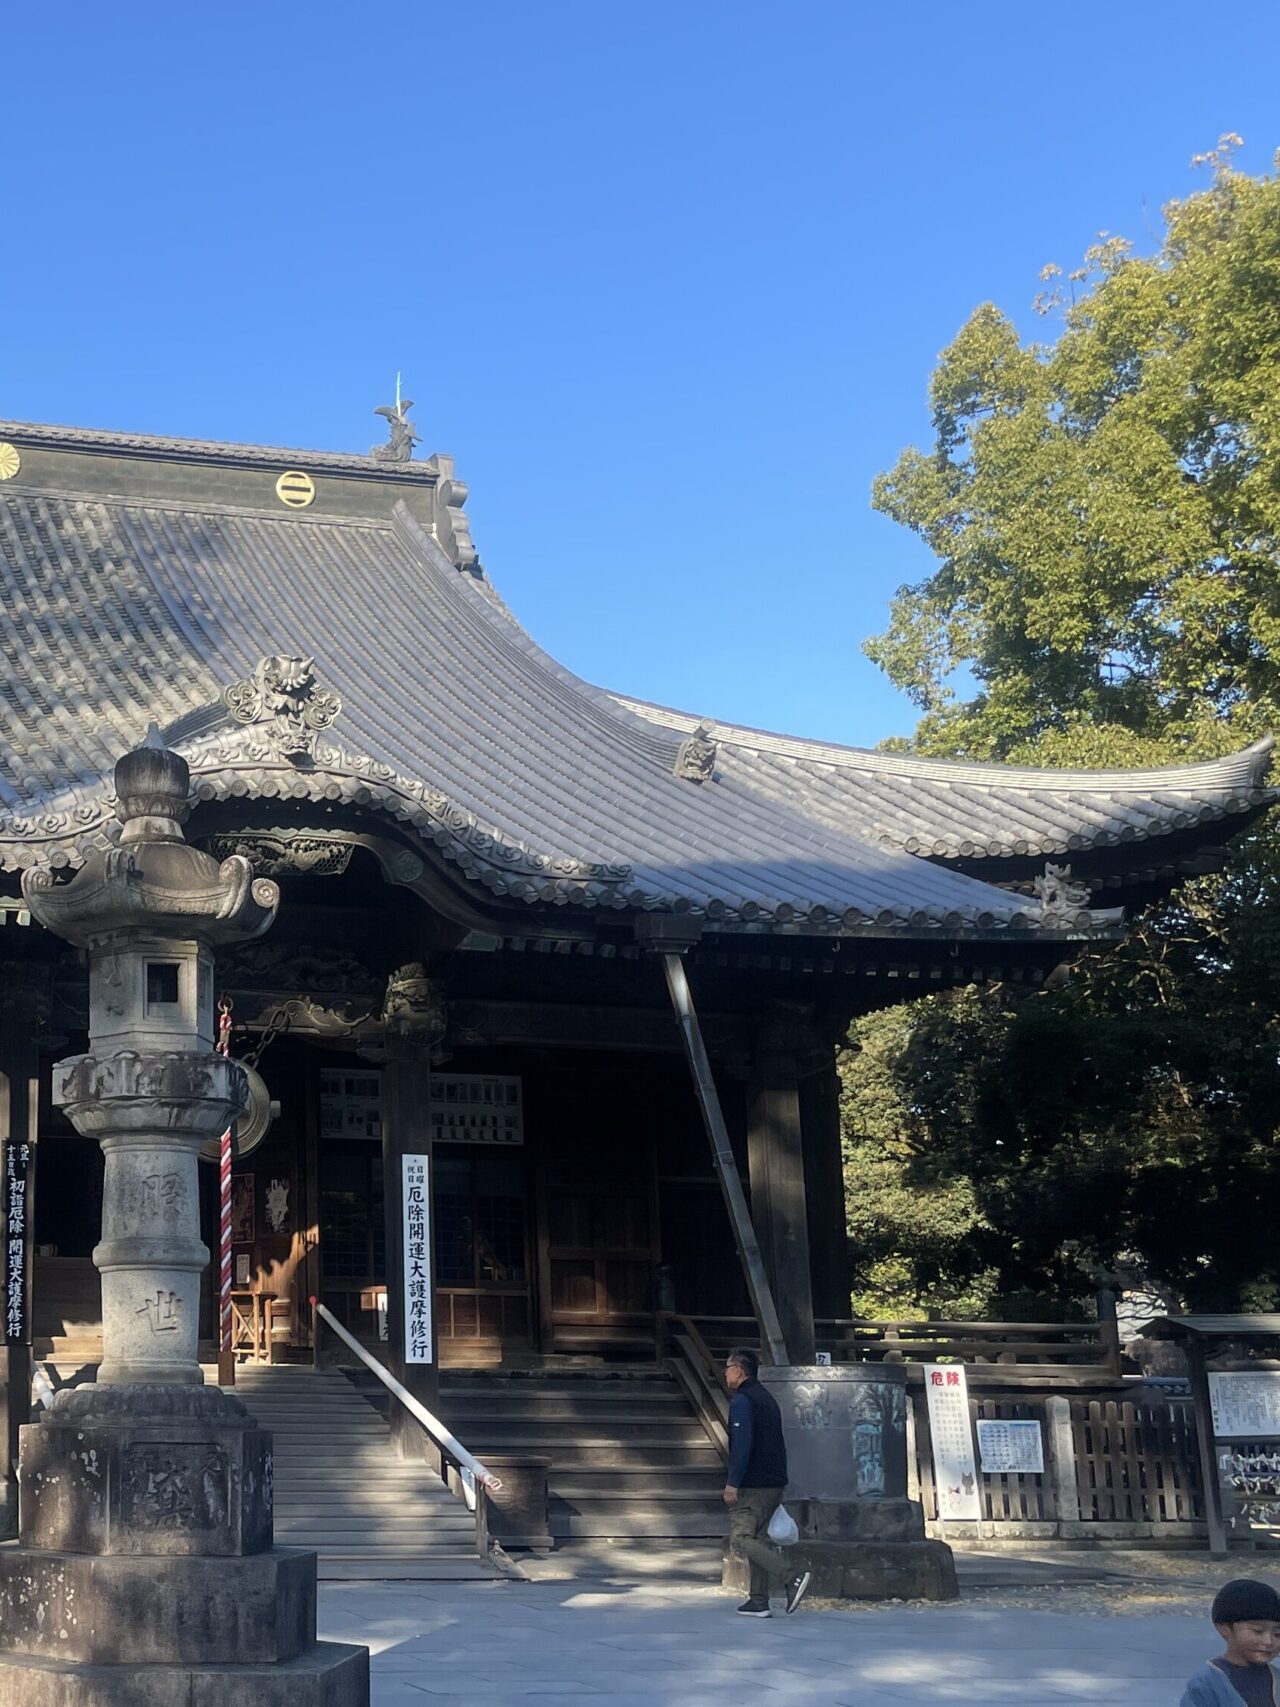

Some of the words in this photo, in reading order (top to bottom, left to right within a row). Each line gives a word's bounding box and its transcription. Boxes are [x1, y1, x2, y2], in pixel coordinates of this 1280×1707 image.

[407, 1186, 429, 1358] 厄除開運大護摩修行
[930, 1371, 961, 1387] 危険
